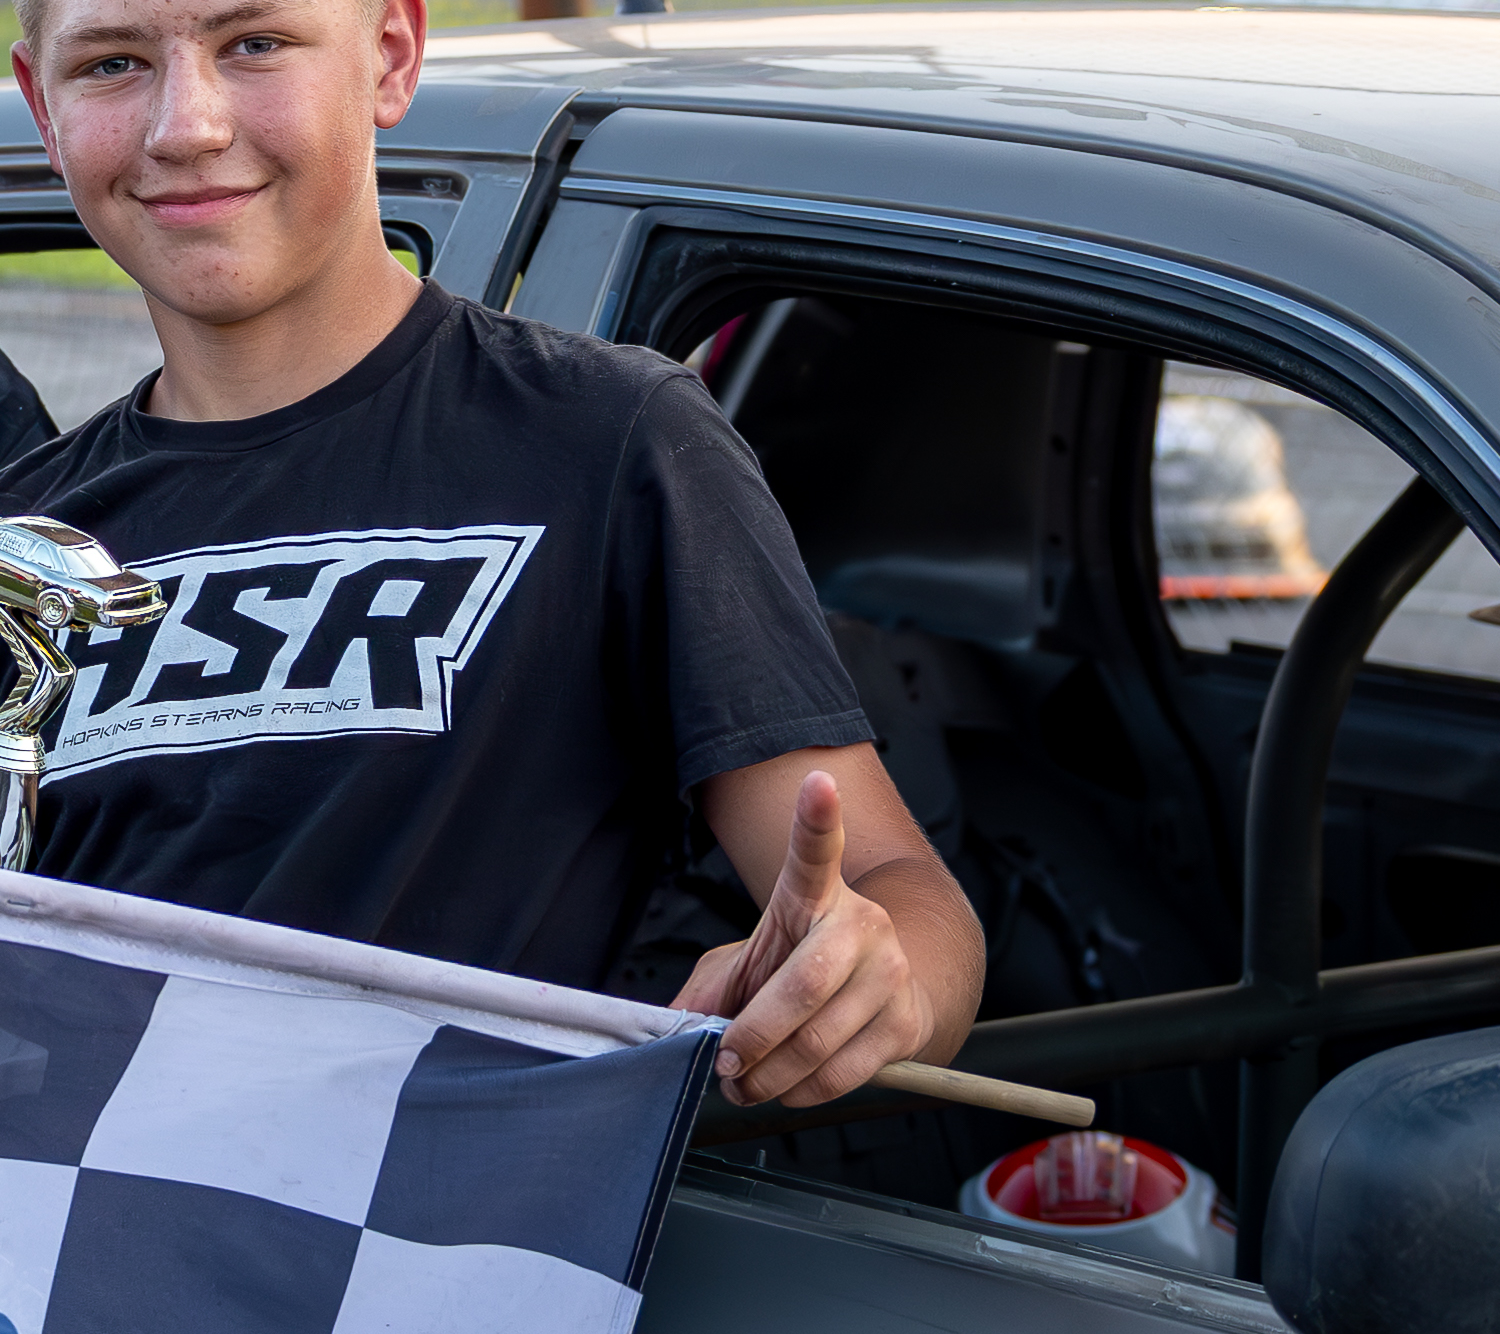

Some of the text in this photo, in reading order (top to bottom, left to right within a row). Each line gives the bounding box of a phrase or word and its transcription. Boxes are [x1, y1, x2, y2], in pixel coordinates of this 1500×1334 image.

[62, 697, 361, 749] HOPKINS STEARNS RACING
